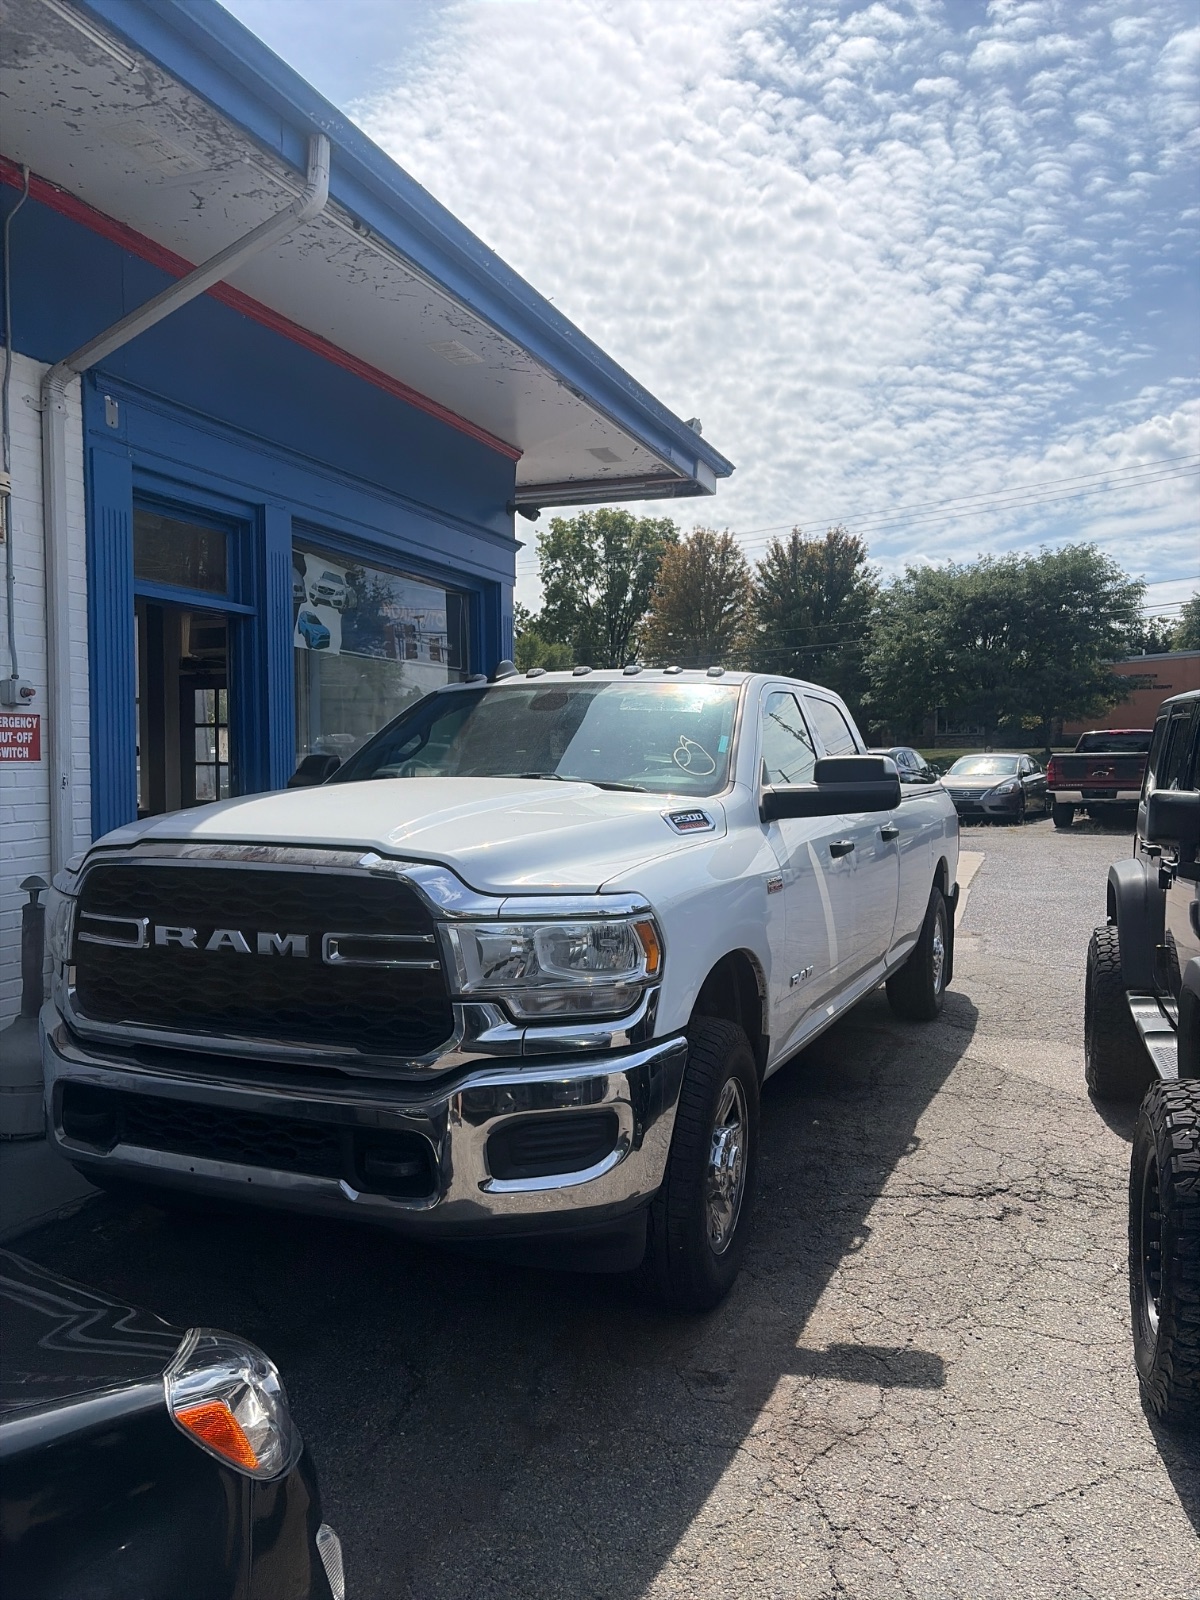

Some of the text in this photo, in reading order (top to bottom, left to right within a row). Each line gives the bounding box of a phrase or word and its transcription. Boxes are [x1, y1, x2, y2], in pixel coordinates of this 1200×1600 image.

[0, 746, 29, 758] WITCH
[672, 813, 704, 823] 2500
[155, 925, 309, 957] RAM
